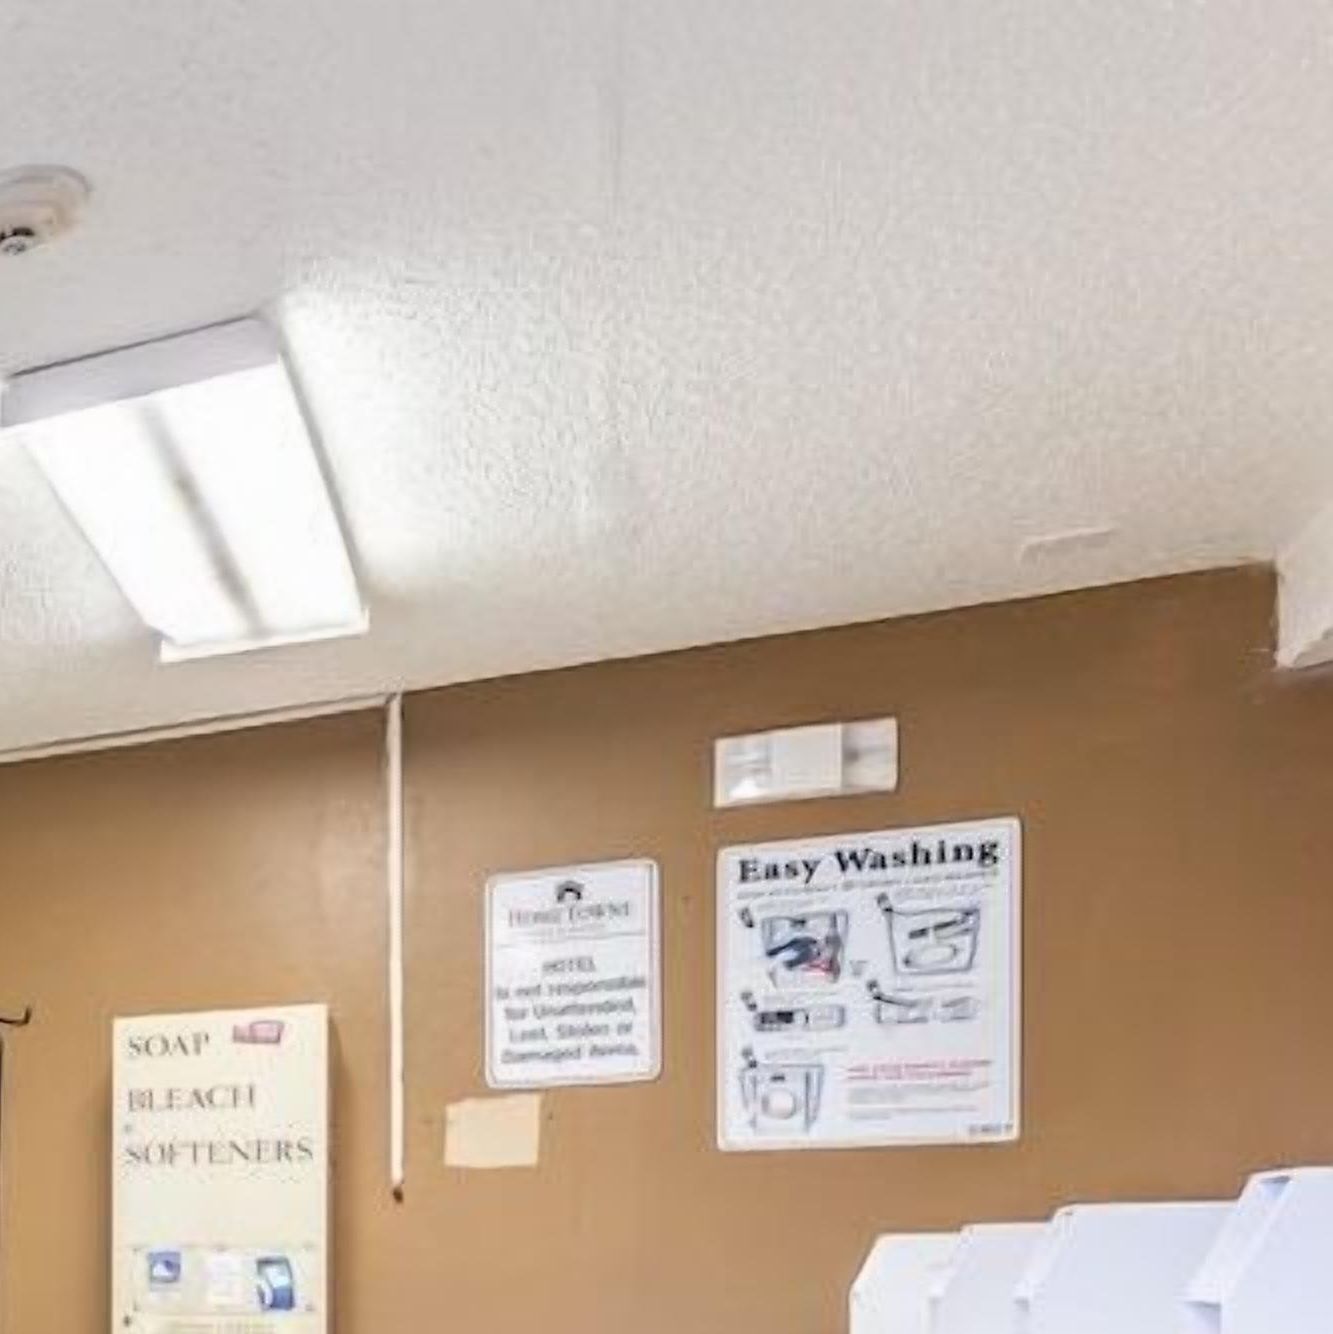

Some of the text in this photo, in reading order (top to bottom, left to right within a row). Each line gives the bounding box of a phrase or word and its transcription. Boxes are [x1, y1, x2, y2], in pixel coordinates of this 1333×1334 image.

[738, 839, 1000, 884] Easy Washing
[126, 1031, 210, 1058] SOAP
[126, 1083, 255, 1112] BLEACH
[123, 1135, 313, 1167] SOFTENERS
